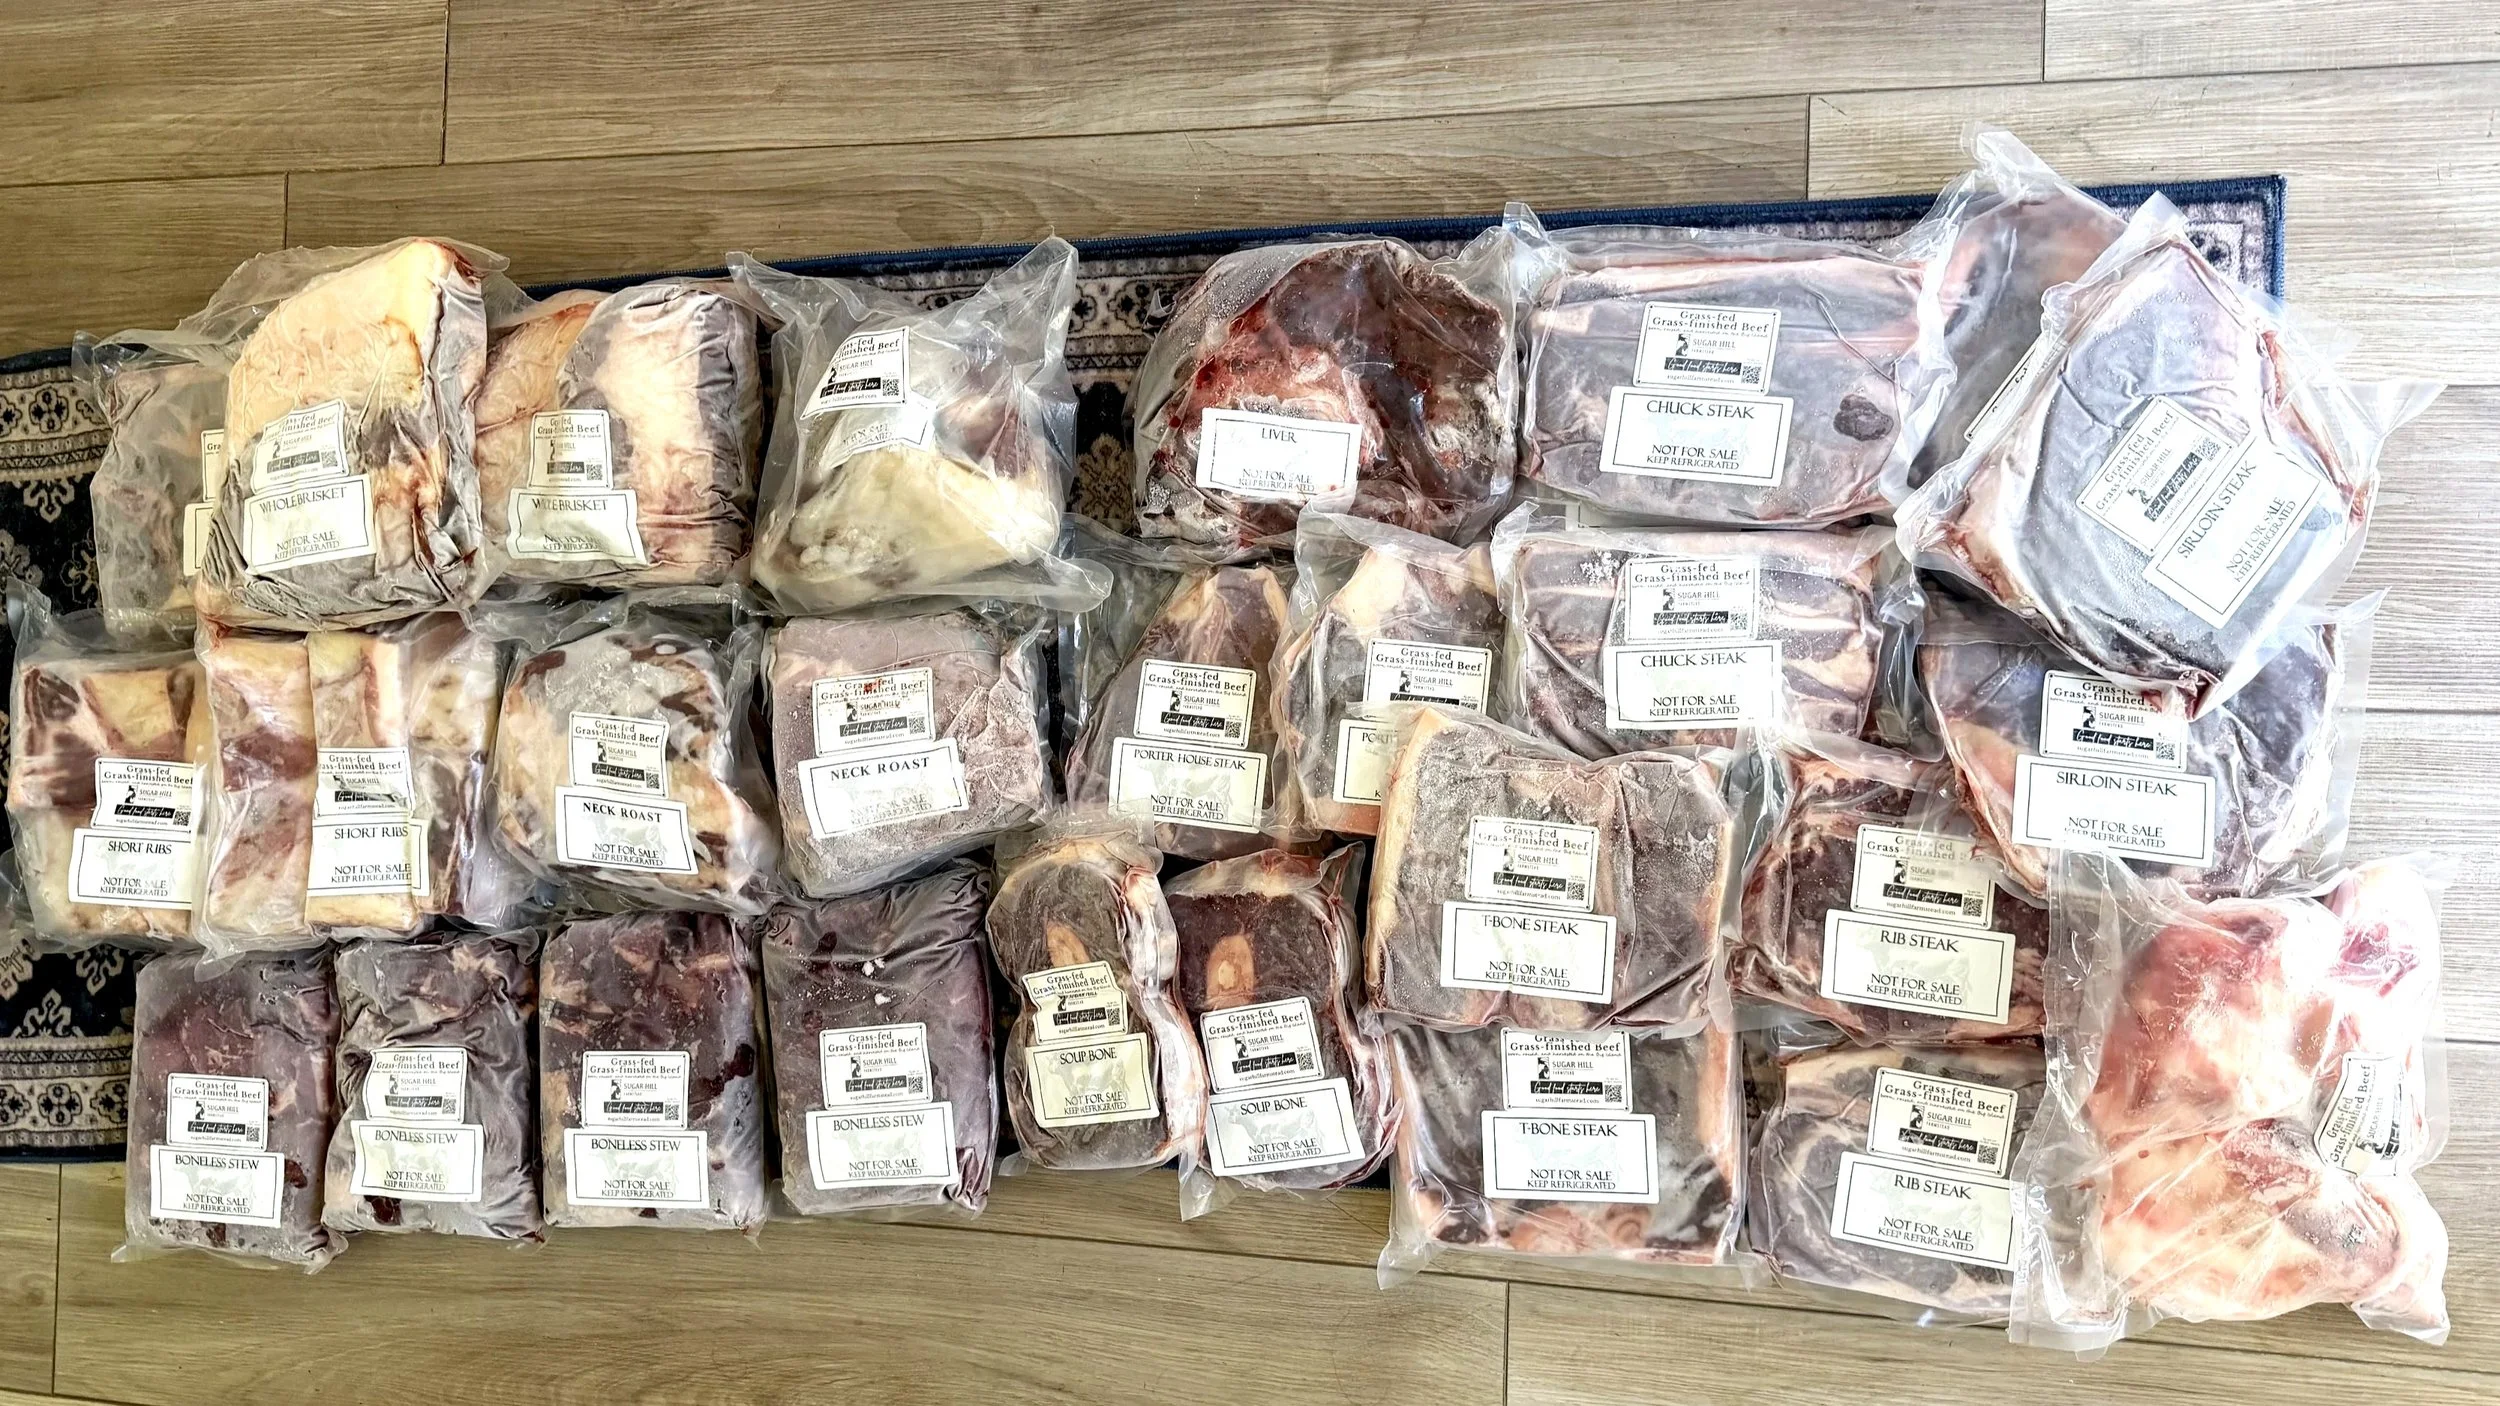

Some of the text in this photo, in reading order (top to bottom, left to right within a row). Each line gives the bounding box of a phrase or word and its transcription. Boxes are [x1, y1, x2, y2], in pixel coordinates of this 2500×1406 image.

[1680, 310, 1736, 322] Grass-fed
[1652, 317, 1737, 331] Grass-finished
[1741, 322, 1769, 333] Beef
[1693, 338, 1736, 348] SUGAR HILL
[1647, 400, 1754, 419] CHUCK STEAK
[1262, 427, 1297, 443] LIVER
[1652, 445, 1737, 460] NOT FOR SALE
[2096, 437, 2155, 510] Grass-finished
[2151, 411, 2174, 443] Beef
[2104, 433, 2145, 484] Grass-fed
[1647, 455, 1739, 470] KEEP REFRIGERATED
[2178, 461, 2257, 558] SIRLOIN STEAK
[2225, 498, 2286, 574] NOT FOR SALE
[1635, 570, 1750, 583] Grass-finished Beef
[1376, 654, 1453, 670] Grass-finished
[1457, 661, 1483, 671] Beef
[1401, 648, 1452, 661] Grass-fed
[1641, 652, 1747, 668] CHUCK STEAK
[1149, 674, 1220, 689] Grass-finished
[1224, 680, 1247, 691] Beef
[1172, 669, 1219, 680] Grass-fed
[1653, 695, 1736, 707] NOT FOR SALE
[2099, 712, 2144, 724] SUGAR HILL
[575, 726, 636, 741] Grass-finished
[639, 734, 660, 743] Beef
[595, 720, 635, 733] Grass-fed
[1134, 749, 1246, 770] PORTER HOUSE STEAK
[104, 771, 172, 783] Grass-finished
[127, 765, 170, 775] Grass-fed
[831, 757, 929, 781] NECK ROAST
[2056, 771, 2177, 796] SIRLOIN STEAK
[1151, 795, 1220, 812] NOT FOR SALE
[583, 802, 662, 823] NECK ROAST
[335, 826, 408, 840] SHORT RIBS
[2068, 817, 2163, 838] NOT FOR SALE
[108, 841, 172, 854] SHORT RIBS
[595, 843, 659, 859] NOT FOR SALE
[1482, 915, 1579, 935] T-BONE STEAK
[1880, 930, 1959, 952] RIB STEAK
[1046, 971, 1084, 984] Grass-fed
[1489, 961, 1568, 978] NOT FOR SALE
[1033, 979, 1089, 995] Grass-finished
[1091, 976, 1108, 985] Beef
[1871, 974, 1960, 995] NOT FOR SALE
[1867, 984, 1962, 1005] KEEP REFRIGERATED
[1209, 1014, 1279, 1035] Grass-finished
[1281, 1012, 1304, 1023] Beef
[1229, 1009, 1274, 1023] Grass-fed
[828, 1038, 918, 1052] Grass-finished Beef
[849, 1032, 892, 1042] Grass-fed
[1510, 1043, 1621, 1052] Grass-finished Beef
[394, 1054, 432, 1062] Grass-fed
[611, 1058, 655, 1066] Grass-fed
[1060, 1047, 1117, 1065] SOUP BONE
[590, 1066, 681, 1074] Grass-finished Beef
[175, 1087, 261, 1099] Grass-finished Beef
[195, 1081, 237, 1090] Grass-fed
[1913, 1080, 1972, 1099] Grass-fed
[1240, 1097, 1307, 1115] SOUP BONE
[1884, 1084, 2006, 1113] Grass-finished Beef
[1927, 1111, 1953, 1124] SUGAR
[1954, 1116, 1972, 1126] HILL
[2327, 1096, 2353, 1138] Grass-fed
[2330, 1096, 2365, 1162] Grass-finished
[2358, 1063, 2370, 1092] Beef
[833, 1114, 925, 1131] BONELESS STEW
[1520, 1122, 1618, 1137] T-BONE STEAK
[375, 1130, 457, 1144] BONELESS STEW
[591, 1138, 680, 1151] BONELESS STEW
[1249, 1138, 1317, 1154] NOT FOR SALE
[175, 1155, 259, 1169] BONELESS STEW
[1530, 1169, 1612, 1181] NOT FOR SALE
[605, 1180, 670, 1190] NOT FOR SALE
[1528, 1180, 1615, 1190] KEEP REFRIGERATED
[1894, 1174, 1972, 1200] RIB STEAK
[186, 1194, 248, 1206] NOT FOR SALE
[1884, 1216, 1973, 1242] NOT FOR SALE
[1878, 1227, 1973, 1251] KEEP REFRIGERATED
